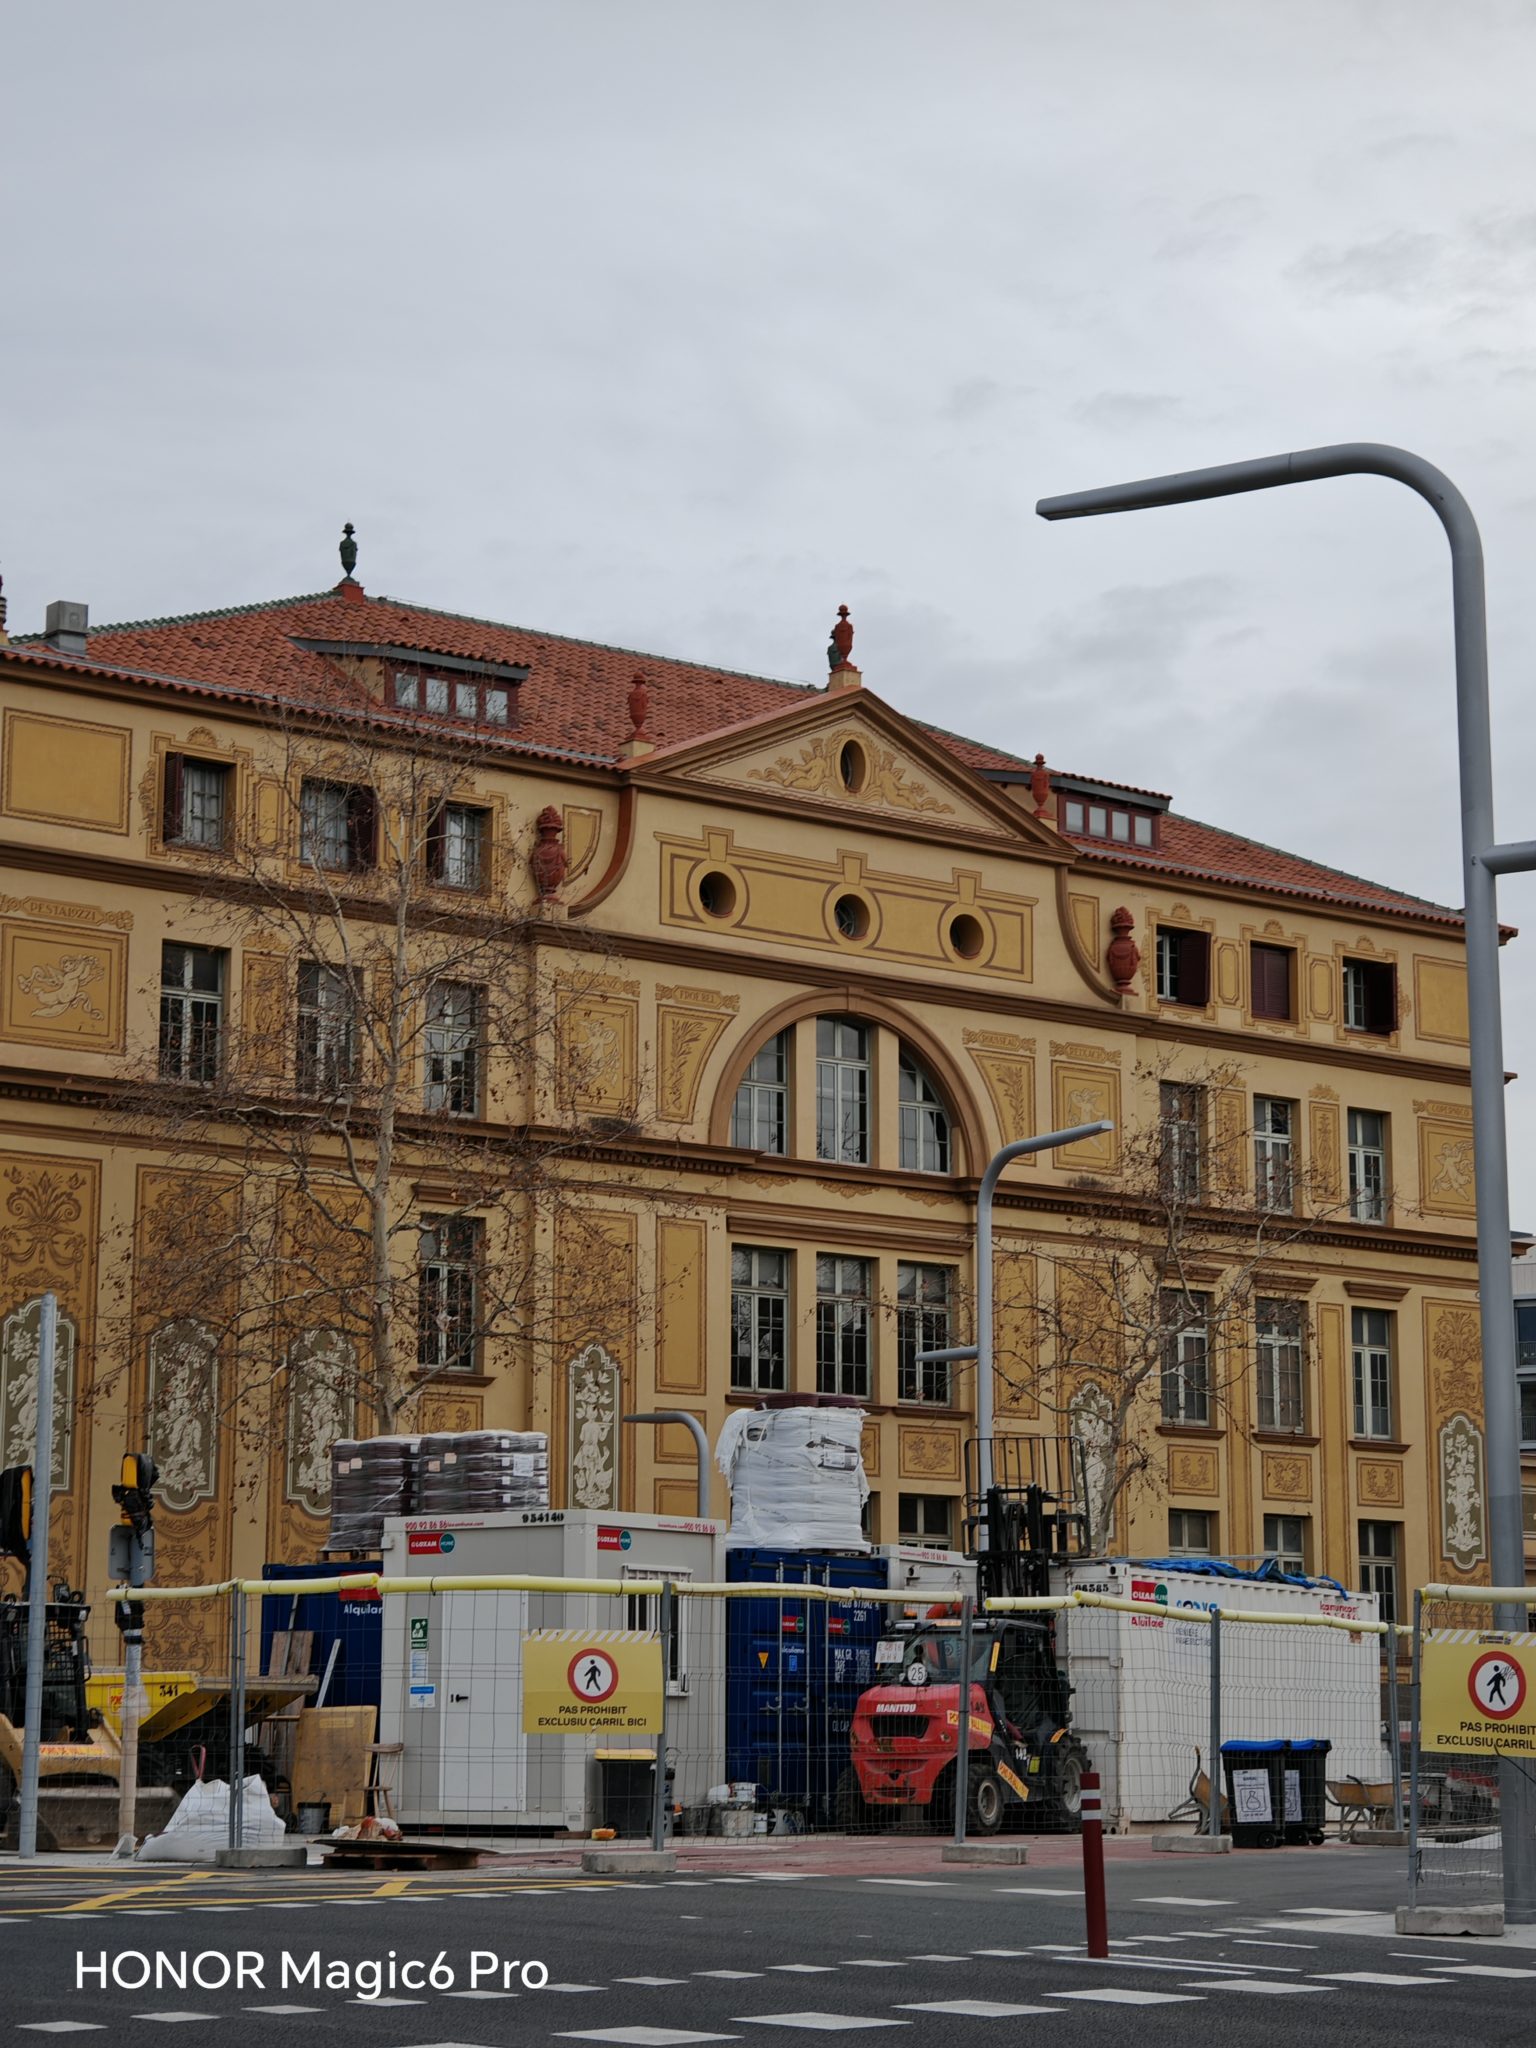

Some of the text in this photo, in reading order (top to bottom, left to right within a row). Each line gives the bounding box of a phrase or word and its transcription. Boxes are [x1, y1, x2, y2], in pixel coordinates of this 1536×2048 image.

[911, 1667, 924, 1682] 25
[558, 1706, 628, 1715] PAS PROHIBIT
[876, 1703, 917, 1713] MANITOU
[538, 1717, 647, 1727] EXCLUSIU CARRIL BICI
[1460, 1721, 1536, 1735] PAS PROHIBIT
[1437, 1734, 1536, 1750] EXCLUSIU CARRIL
